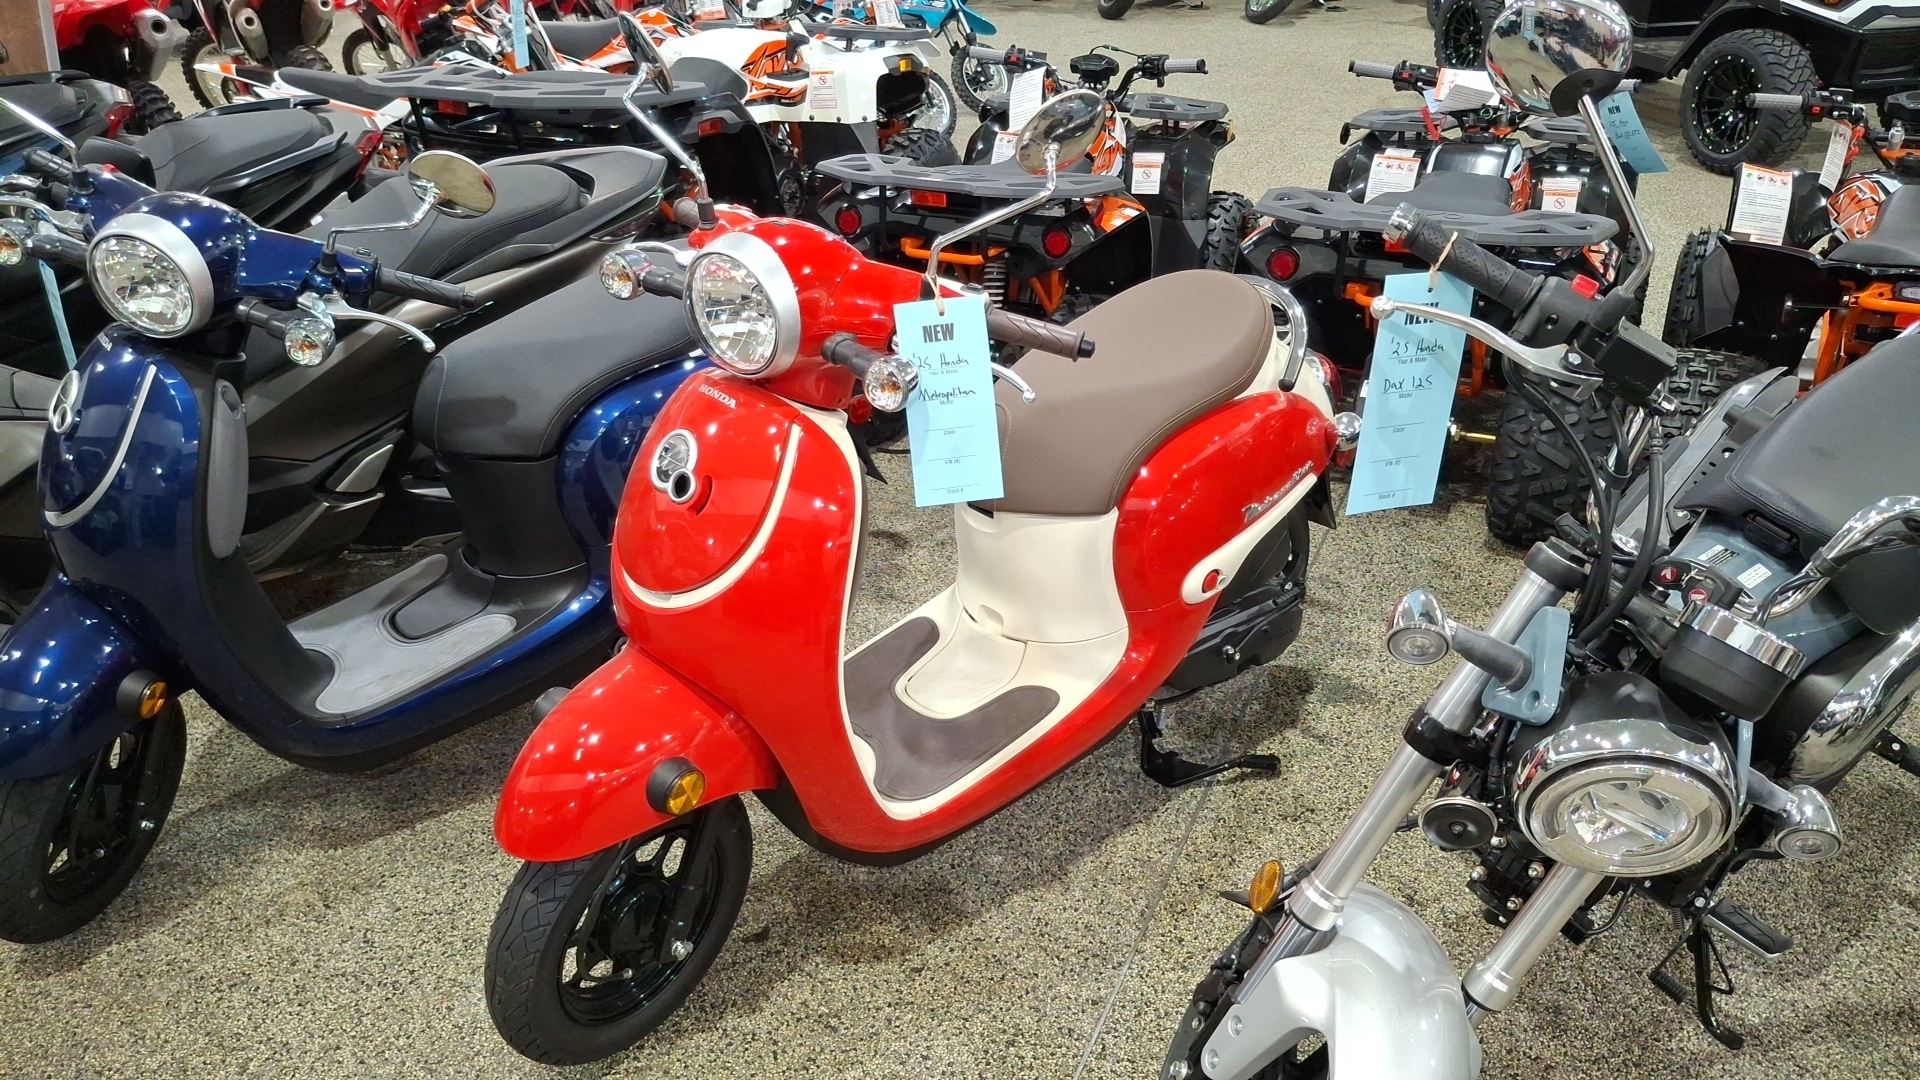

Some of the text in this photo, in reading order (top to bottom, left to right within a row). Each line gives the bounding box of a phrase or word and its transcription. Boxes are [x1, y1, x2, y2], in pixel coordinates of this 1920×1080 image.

[1608, 105, 1621, 115] NEW
[923, 323, 954, 343] NEW
[1416, 338, 1444, 353] Honda
[940, 352, 969, 366] Honda
[698, 384, 737, 410] HONDA
